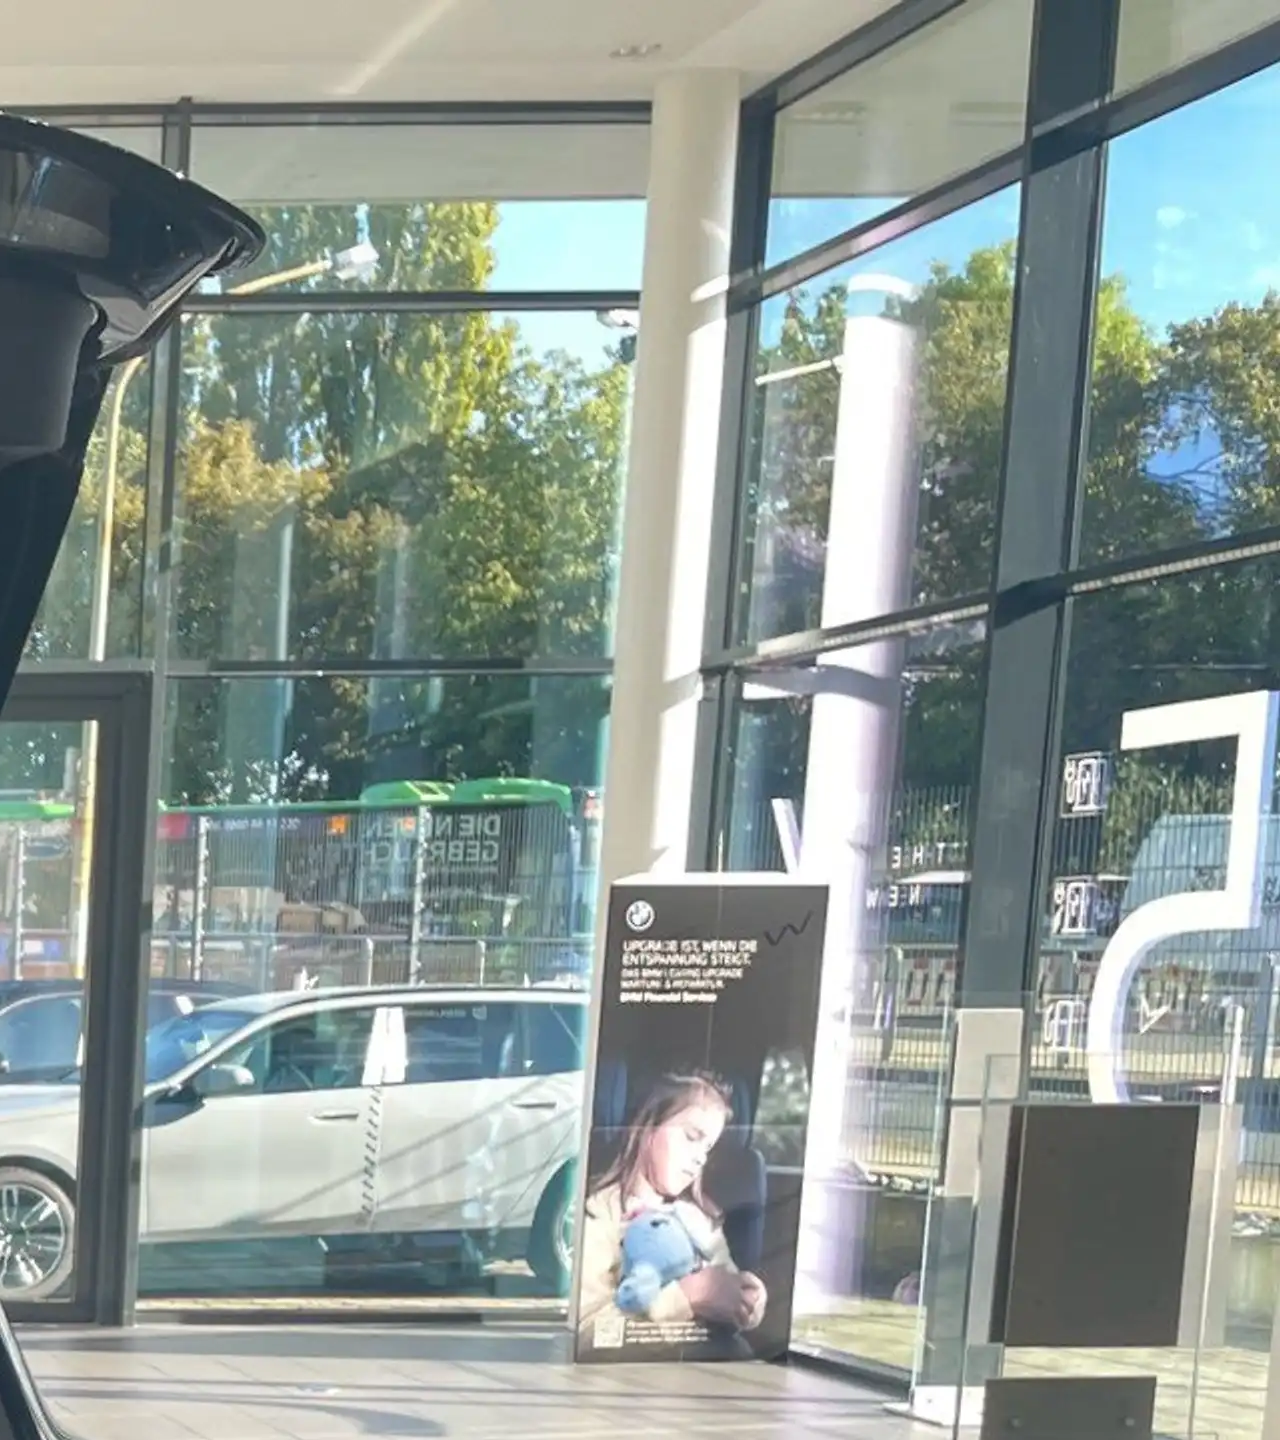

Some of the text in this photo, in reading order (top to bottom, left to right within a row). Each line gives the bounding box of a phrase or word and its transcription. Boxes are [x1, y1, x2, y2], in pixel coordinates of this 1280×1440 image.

[623, 940, 678, 953] UPGRADE
[702, 940, 737, 953] WENN
[739, 940, 758, 953] DIE
[622, 953, 708, 966] ENTSPANNUNG
